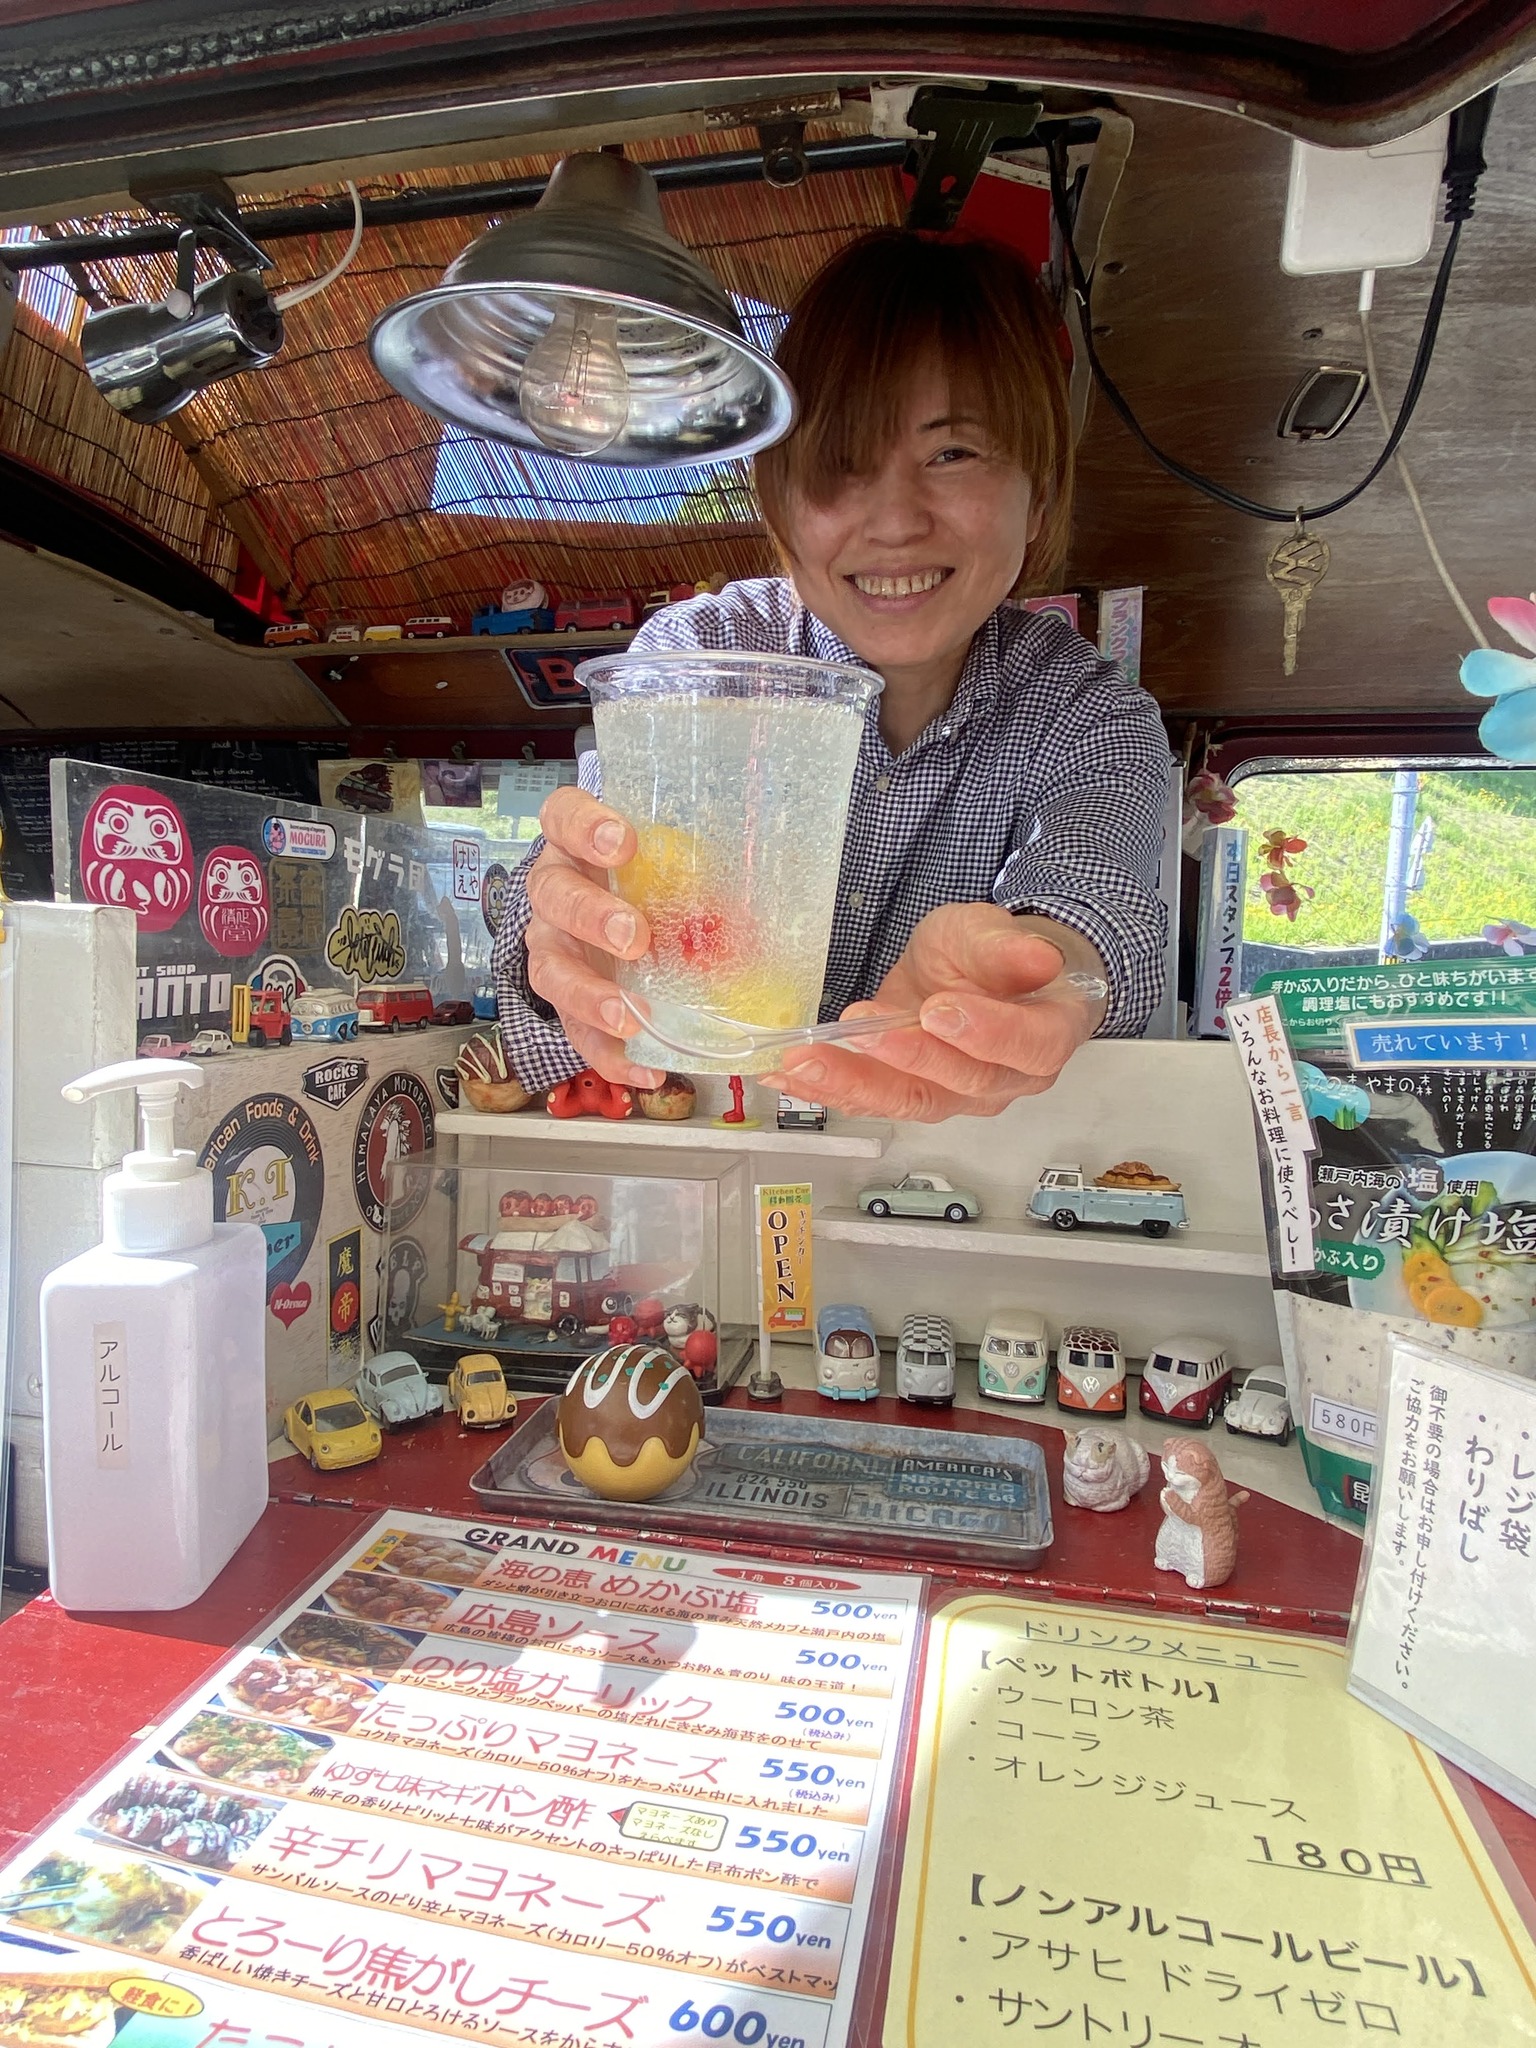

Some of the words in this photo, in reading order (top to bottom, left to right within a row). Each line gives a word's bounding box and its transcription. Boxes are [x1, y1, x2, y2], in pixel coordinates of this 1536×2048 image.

[290, 832, 326, 849] MOGURA
[156, 964, 196, 977] SHOP
[315, 1063, 359, 1085] ROCKS
[1256, 1005, 1304, 1123] 店長から一言
[1365, 1073, 1433, 1097] やまの森
[327, 1081, 348, 1103] CAFE
[204, 1117, 242, 1172] erican
[245, 1098, 284, 1123] Foods
[287, 1105, 299, 1126] &
[356, 1087, 389, 1185] HIMALAYA
[394, 1075, 433, 1145] MOTORCYCL
[767, 1209, 797, 1303] OPEN
[1313, 1246, 1379, 1272] かぶ入り
[99, 1340, 124, 1452] アルコール
[705, 1481, 830, 1510] ILLINOIS
[902, 1458, 1013, 1482] AMERICA'S
[988, 1493, 1017, 1504] 66
[464, 1526, 580, 1556] GRAND
[586, 1545, 688, 1572] MENU
[492, 1558, 597, 1589] 海の恵
[600, 1573, 765, 1616] めかぶ塩
[456, 1603, 662, 1655] 広島ソース
[1022, 1619, 1300, 1670] ドリンクメニュー
[411, 1655, 713, 1721] のり塩ガーリック
[996, 1685, 1176, 1731] ウーロン茶
[359, 1700, 728, 1785] たっぷりマヨネーズ
[995, 1719, 1102, 1753] コーラ
[993, 1755, 1308, 1823] オレンジジュース
[268, 1824, 666, 1935] 辛チリマヨネーズ
[1252, 1834, 1427, 1886] 180円
[191, 1905, 650, 2039] とろーり焦がしチーズ
[990, 1929, 1128, 1984] アサヒ
[1162, 1959, 1403, 2037] ドライゼロ
